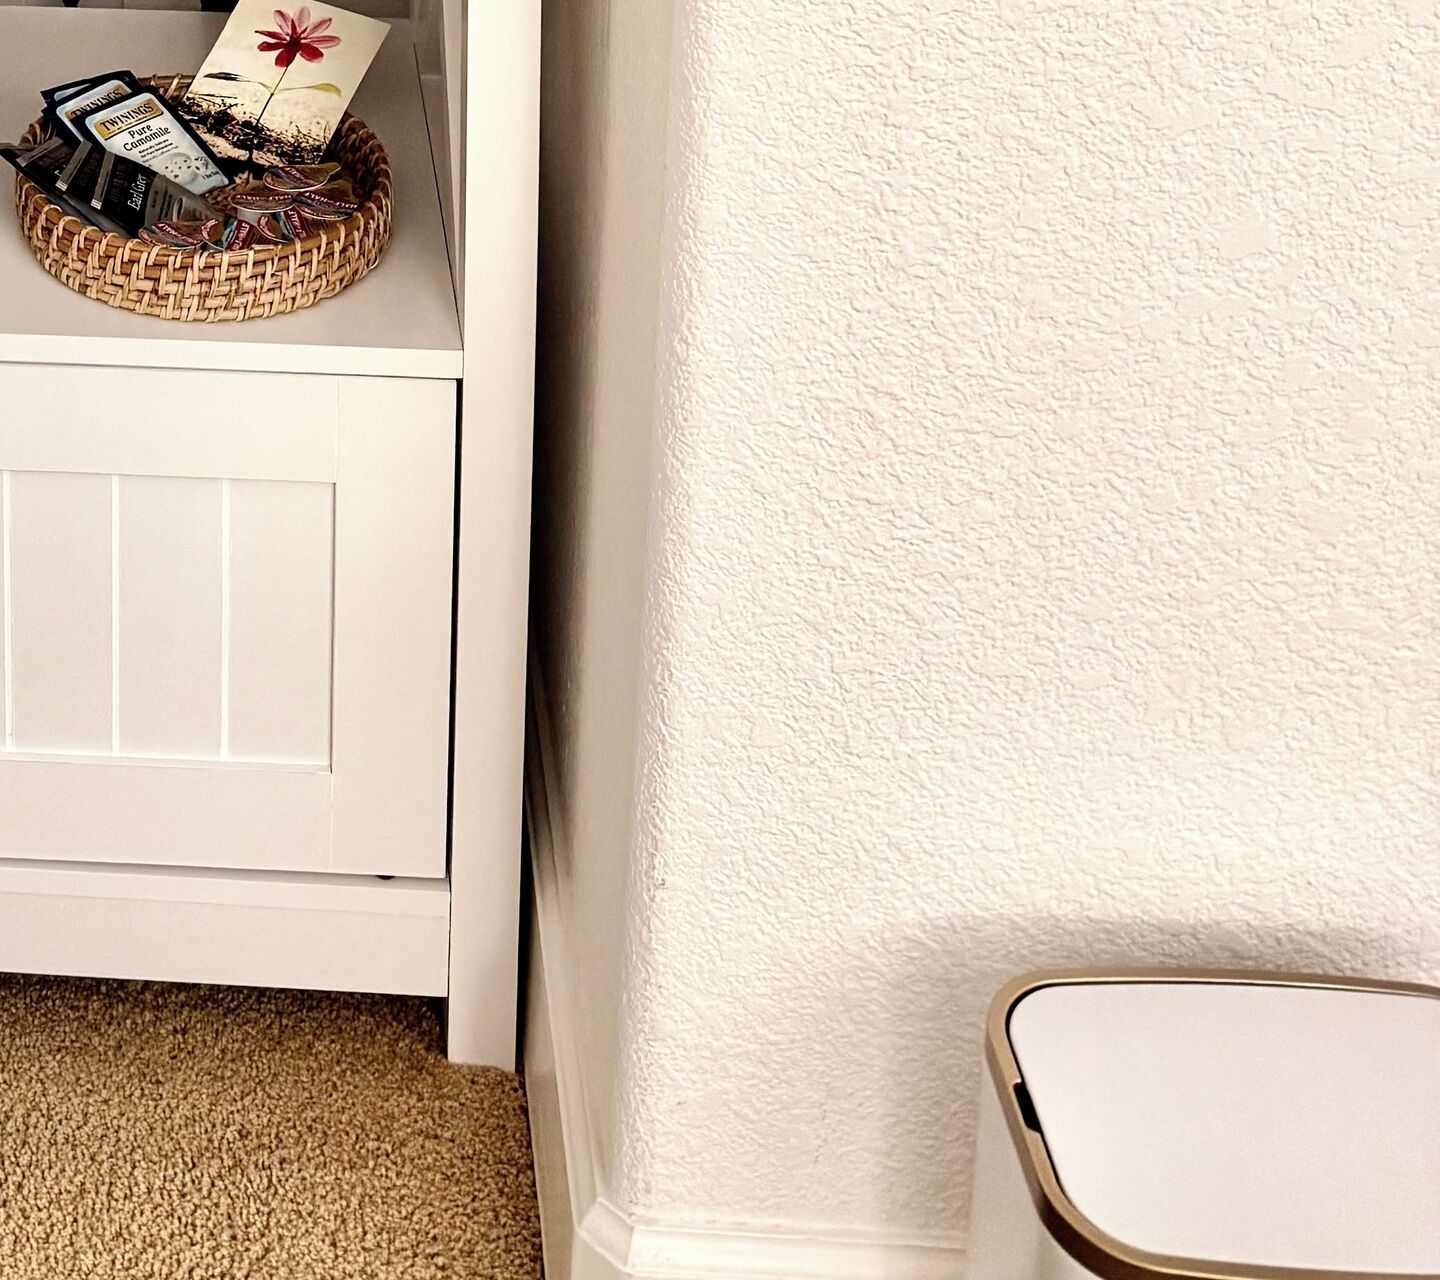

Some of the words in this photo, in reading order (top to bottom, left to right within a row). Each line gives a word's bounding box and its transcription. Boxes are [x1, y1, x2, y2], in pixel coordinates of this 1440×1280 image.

[100, 104, 154, 132] TWININGS
[123, 126, 172, 152] Camomile
[128, 124, 154, 140] Pure
[135, 173, 151, 193] Grey
[128, 190, 143, 211] Earl
